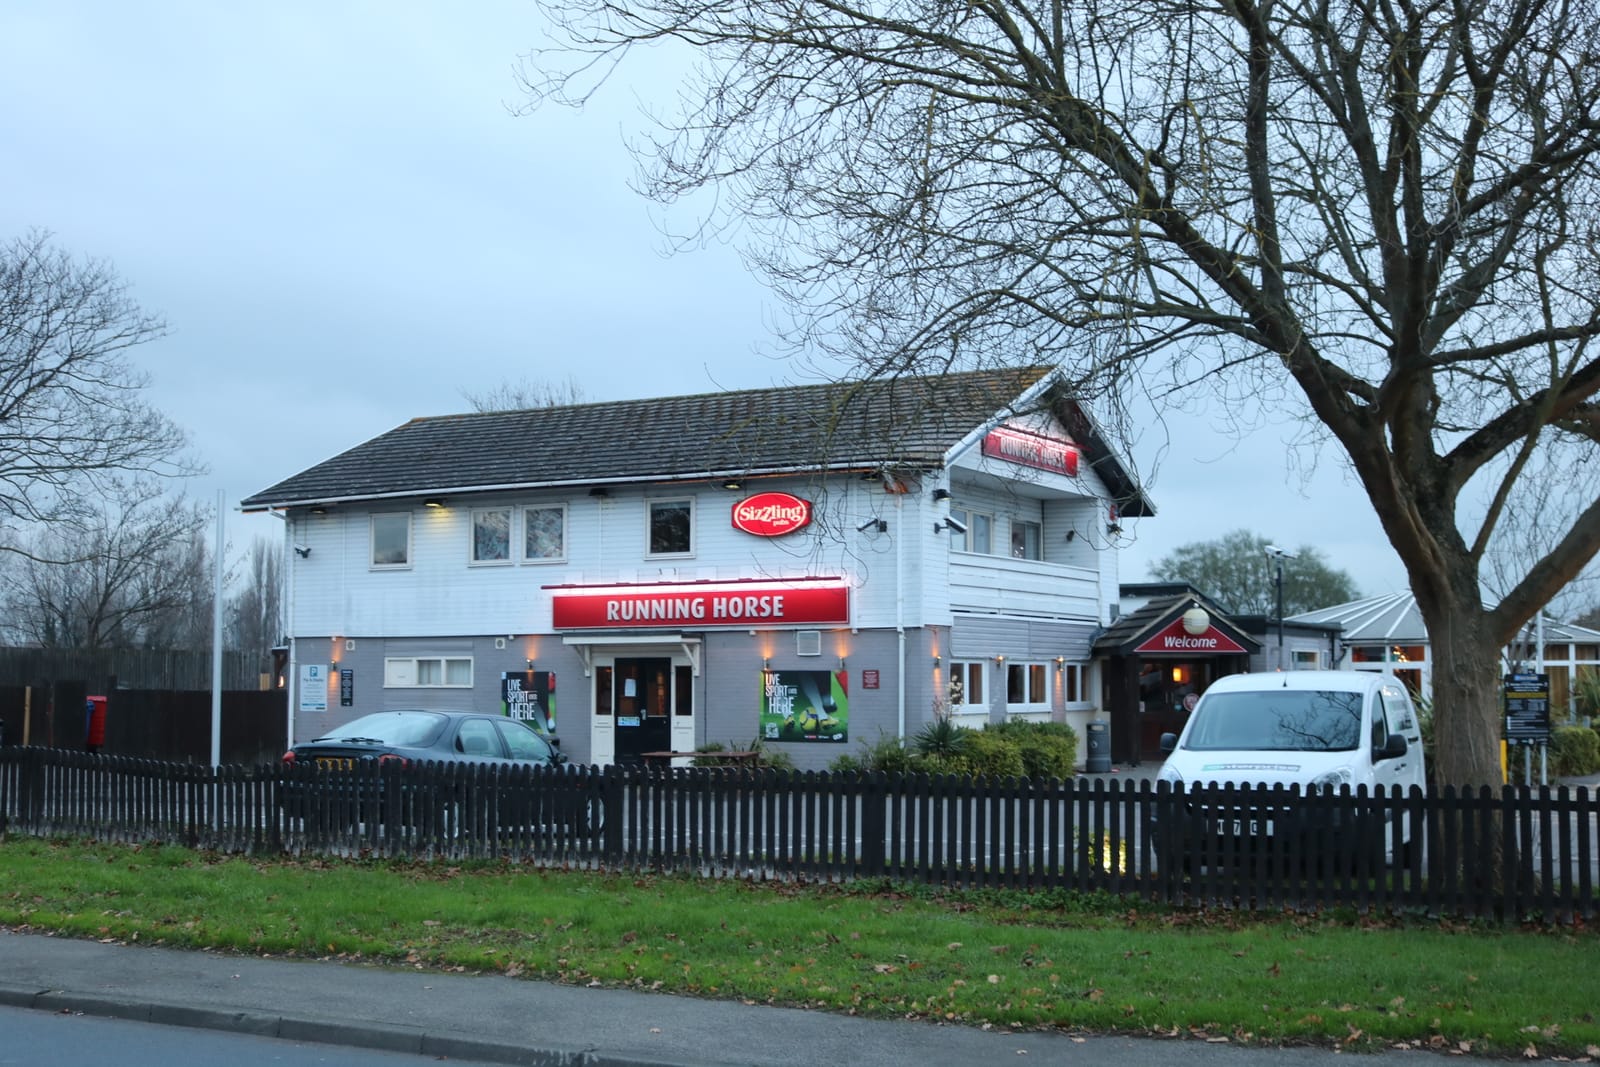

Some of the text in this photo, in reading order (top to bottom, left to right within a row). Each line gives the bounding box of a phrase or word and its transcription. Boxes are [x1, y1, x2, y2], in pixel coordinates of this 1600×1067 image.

[607, 596, 784, 621] RUNNING HORSE
[1164, 635, 1217, 648] Welcome
[507, 679, 521, 691] LIVE
[765, 673, 780, 686] LIVE
[507, 690, 529, 703] SPORT
[765, 685, 788, 697] SPORT
[510, 702, 536, 720] HERE
[768, 696, 795, 714] HERE
